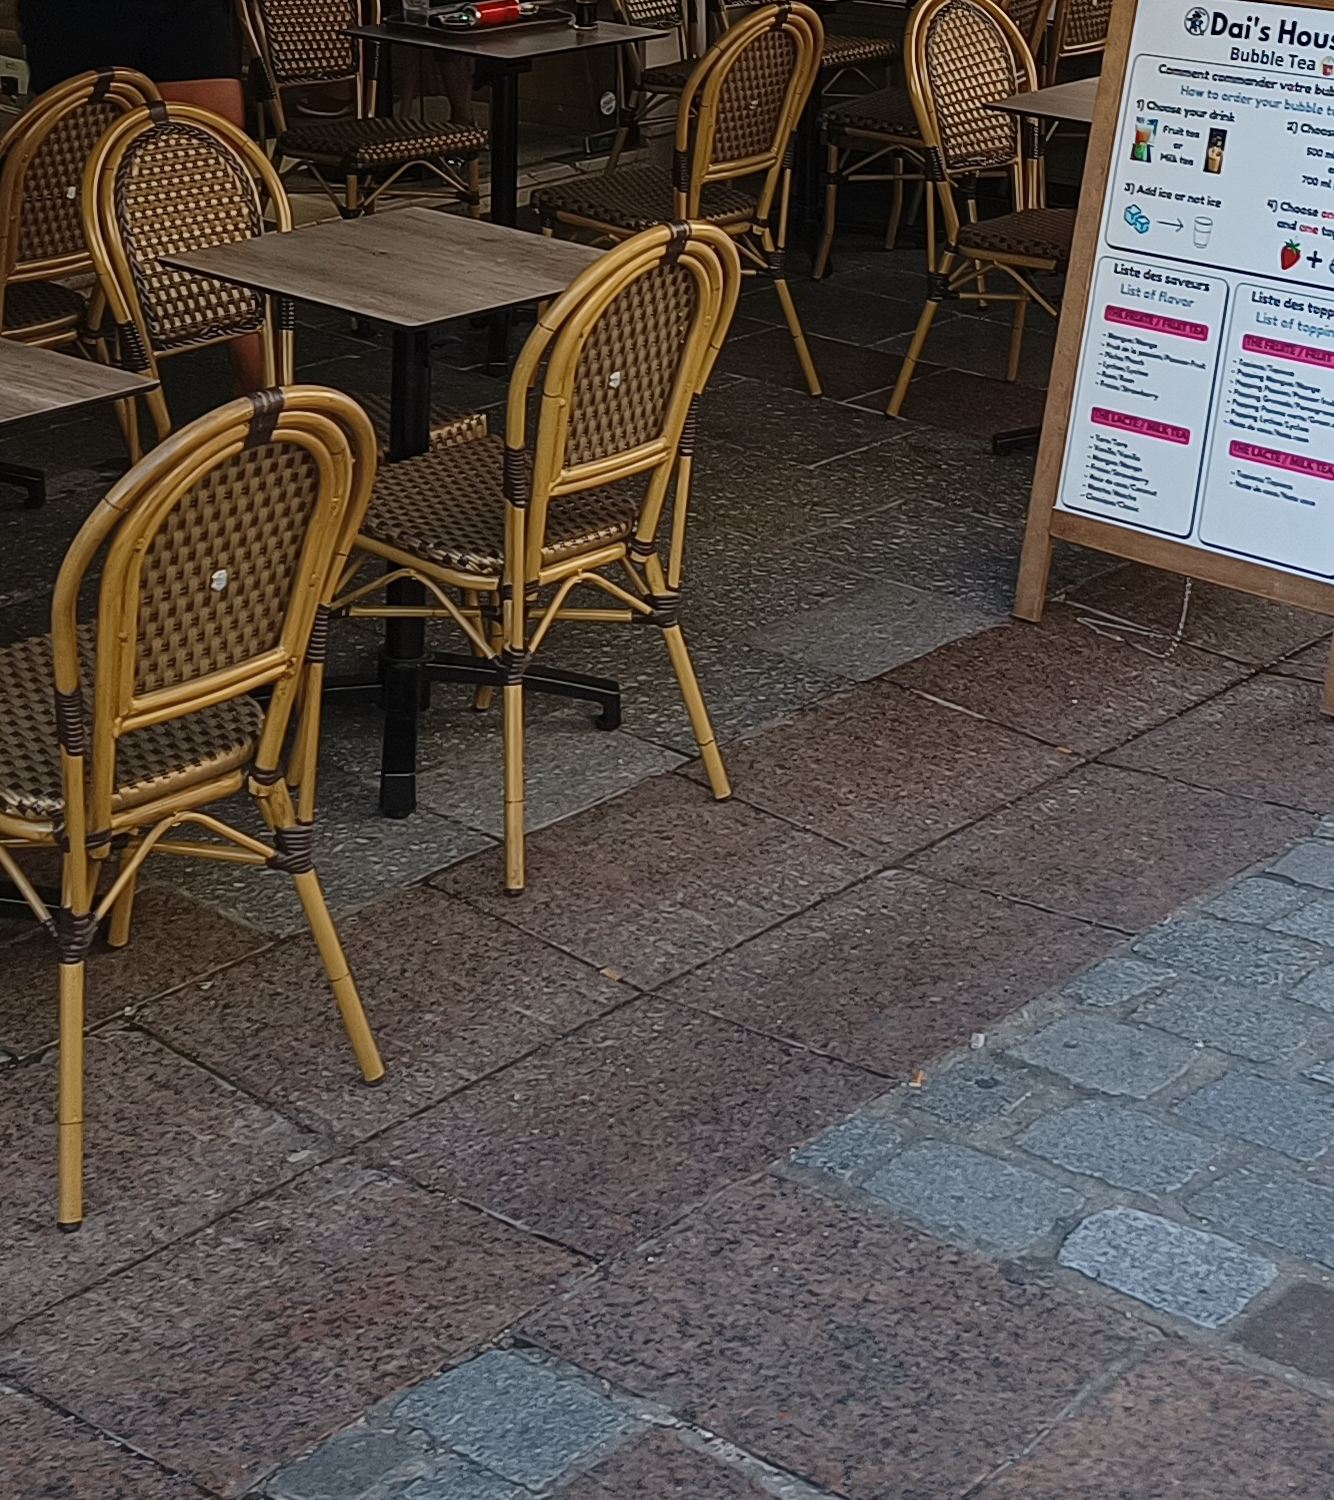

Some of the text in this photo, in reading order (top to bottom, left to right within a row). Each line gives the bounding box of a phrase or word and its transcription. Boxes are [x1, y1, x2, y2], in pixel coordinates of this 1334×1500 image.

[1210, 12, 1271, 43] Dai's
[1230, 46, 1317, 72] Bubble Tea
[1158, 64, 1210, 81] Comment
[1212, 72, 1278, 91] commander
[1147, 101, 1182, 117] Choose
[1183, 107, 1208, 120] your
[1208, 108, 1236, 124] drink
[1180, 85, 1204, 100] How
[1206, 89, 1219, 101] to
[1221, 91, 1254, 106] order
[1254, 96, 1283, 110] your
[1284, 99, 1324, 117] bubble
[1286, 121, 1299, 135] 2)
[1301, 175, 1320, 188] 700
[1123, 182, 1222, 209] 3) Add ice or not ice
[1280, 201, 1319, 218] Choose
[1276, 219, 1297, 232] and
[1298, 223, 1319, 235] one
[1113, 262, 1210, 292] Liste des saveurs
[1120, 282, 1195, 308] List of flavor
[1251, 290, 1281, 308] Liste
[1283, 298, 1305, 312] des
[1255, 311, 1278, 327] List
[1280, 318, 1295, 330] of
